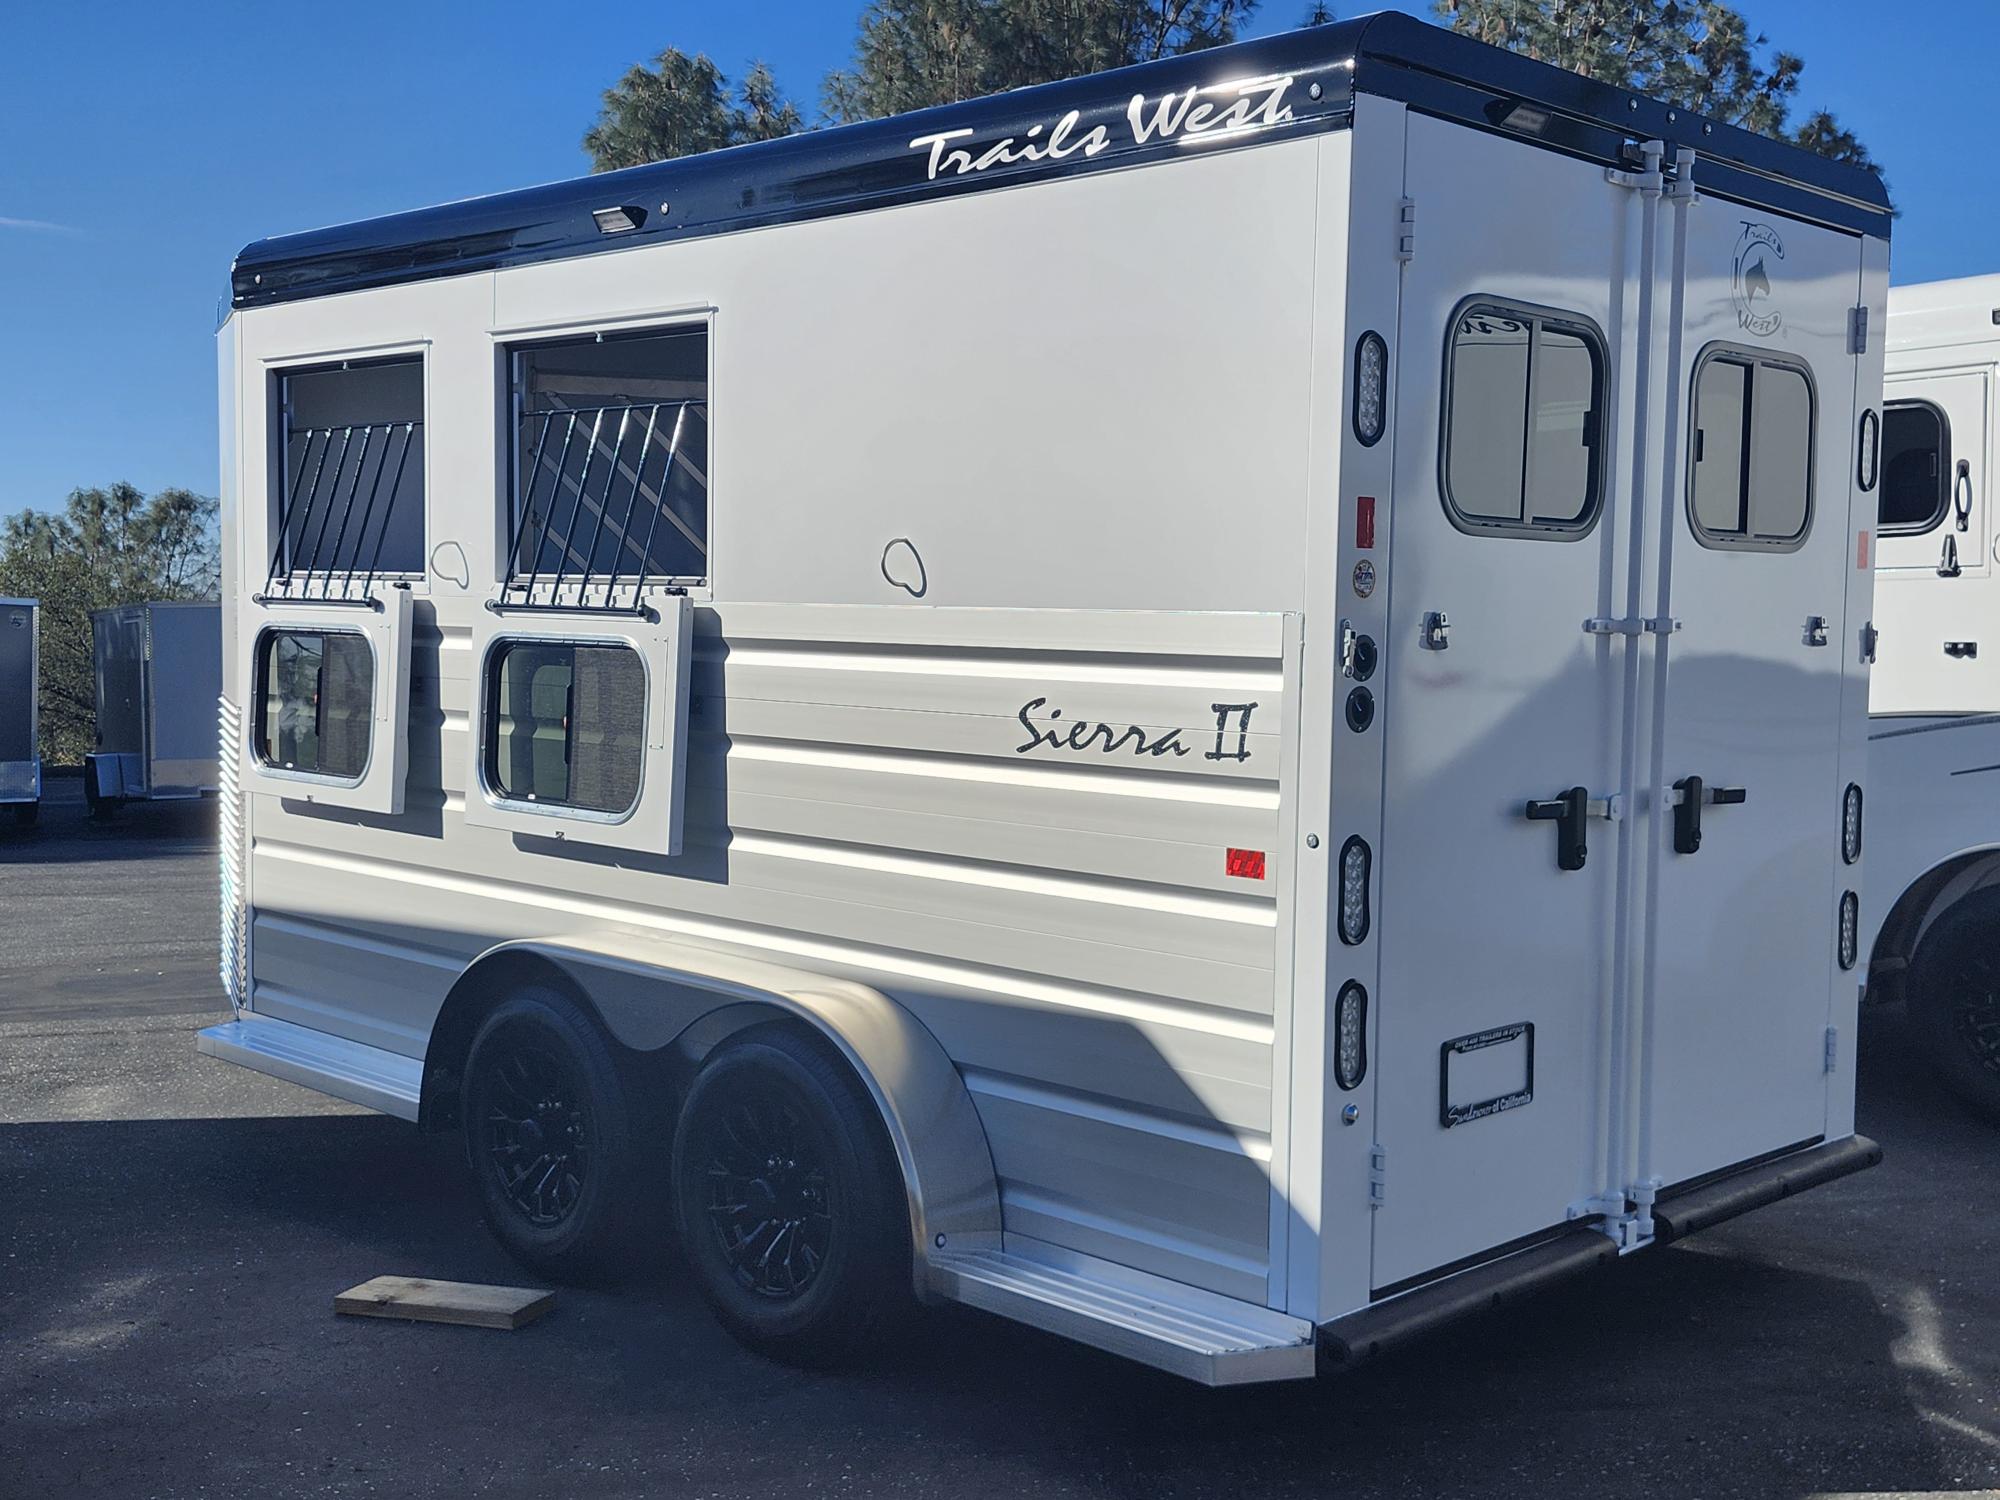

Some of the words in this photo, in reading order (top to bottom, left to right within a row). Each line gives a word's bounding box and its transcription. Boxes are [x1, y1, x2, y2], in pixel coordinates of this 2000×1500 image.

[909, 110, 1110, 180] Trails
[1127, 77, 1293, 144] West
[1740, 221, 1777, 245] Trails
[1738, 309, 1772, 332] West
[1016, 697, 1191, 757] Sierra
[1204, 701, 1259, 763] II
[1492, 1099, 1499, 1113] of
[1500, 1091, 1532, 1111] California
